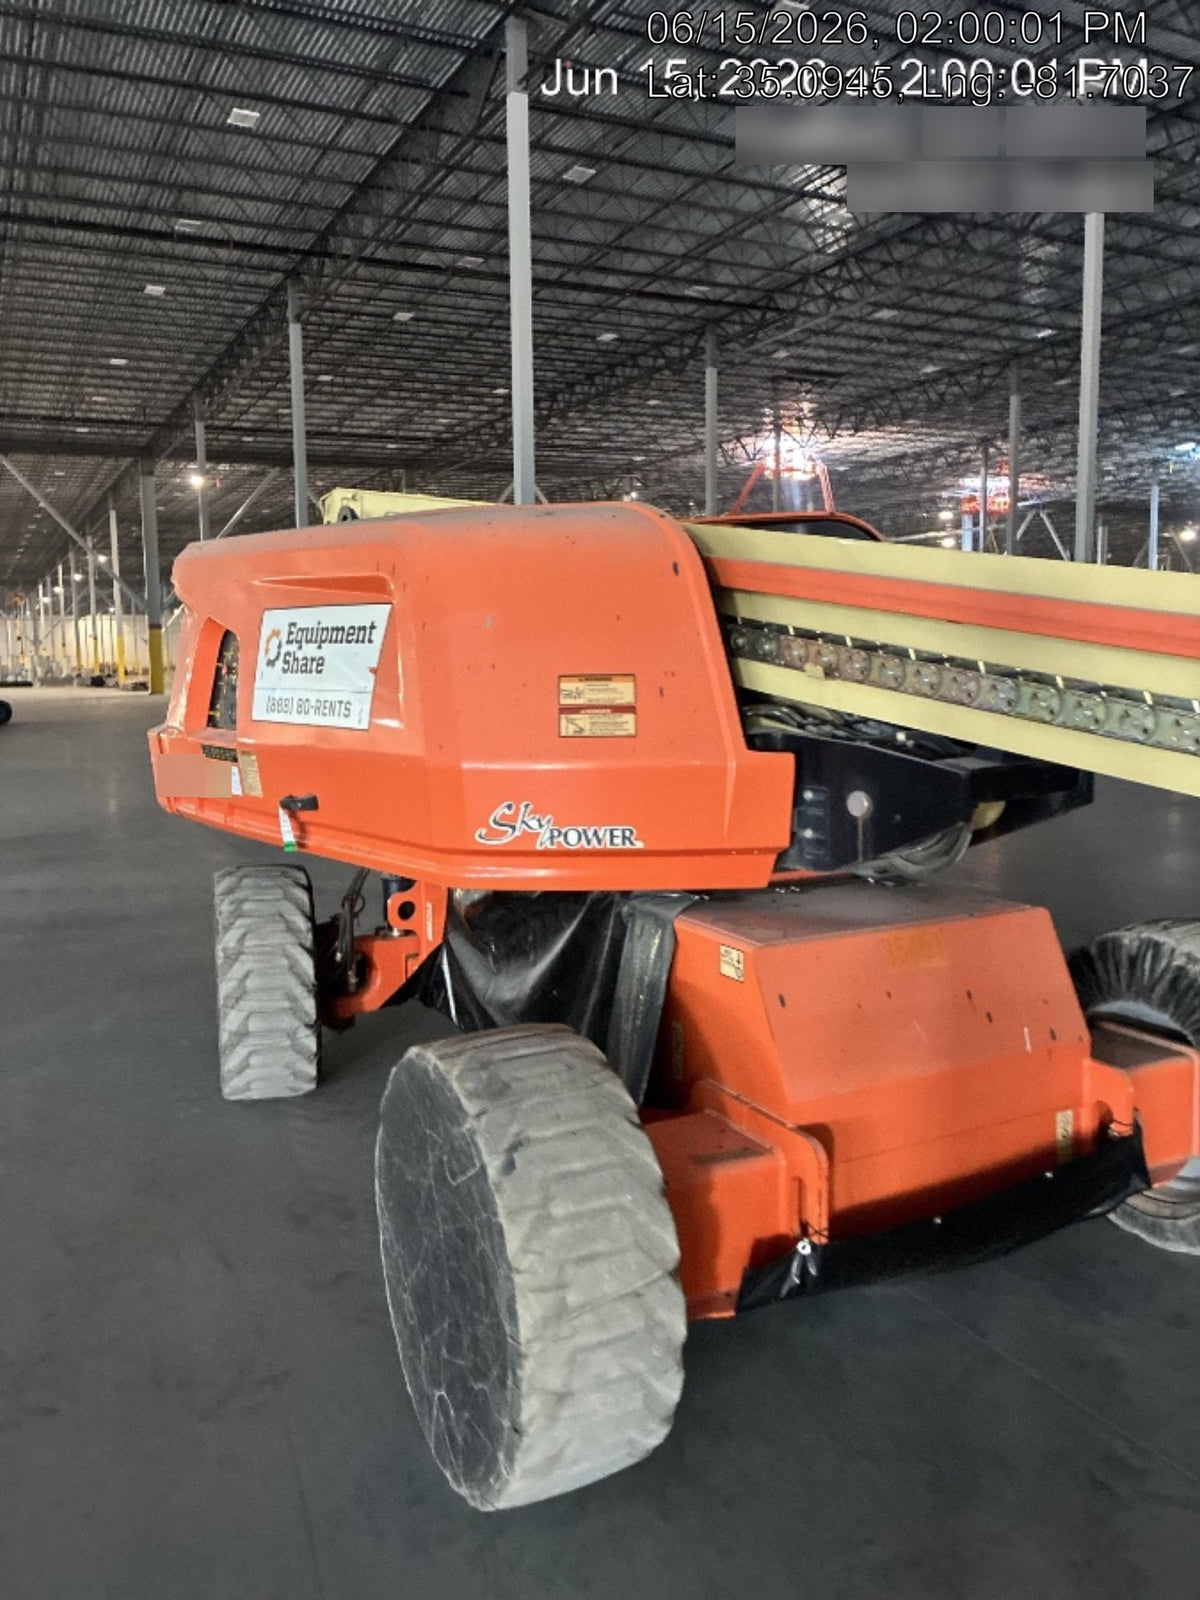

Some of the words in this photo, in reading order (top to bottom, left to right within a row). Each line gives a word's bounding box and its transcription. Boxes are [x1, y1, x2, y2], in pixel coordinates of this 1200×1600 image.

[285, 620, 377, 650] Equipment
[281, 651, 326, 675] Share
[476, 801, 553, 849] Sky
[549, 827, 643, 848] POWER
